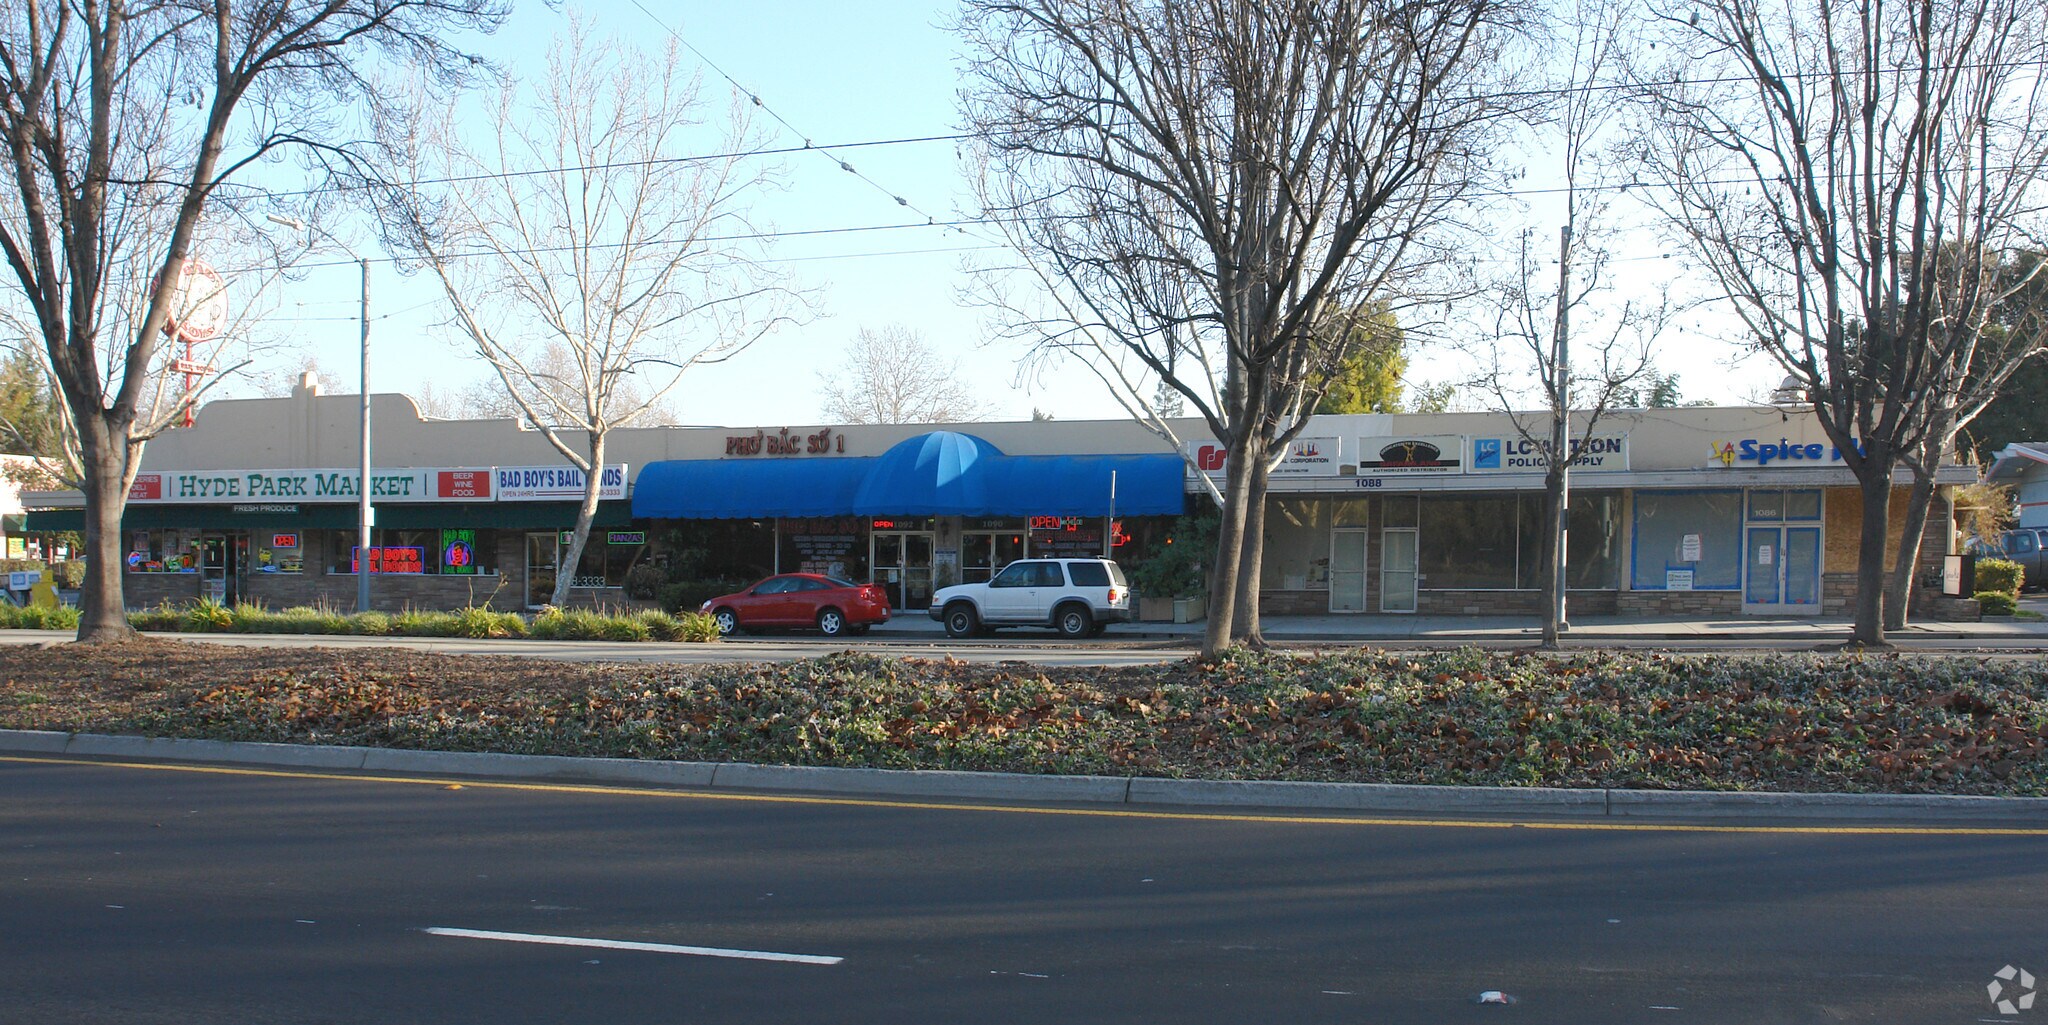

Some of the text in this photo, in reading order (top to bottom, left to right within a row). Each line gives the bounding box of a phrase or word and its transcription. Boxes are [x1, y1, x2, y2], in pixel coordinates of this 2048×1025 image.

[836, 434, 845, 453] 1
[1481, 442, 1495, 452] LC
[1739, 437, 1824, 465] Spice
[1508, 457, 1549, 467] POLIC
[500, 469, 621, 488] BAD BOY'S BAIL NDS
[1355, 479, 1382, 487] 1088
[179, 473, 414, 497] HYDE PARK MAKET
[234, 504, 297, 512] FRESH PRODUCE
[1755, 509, 1776, 517] 1086
[873, 520, 894, 528] OPEN
[894, 520, 913, 528] 1092
[982, 520, 1003, 528] 1090
[1030, 516, 1060, 528] OPEN
[274, 535, 295, 546] OPEN
[609, 534, 642, 542] FIANZAS
[383, 560, 422, 573] BONDS
